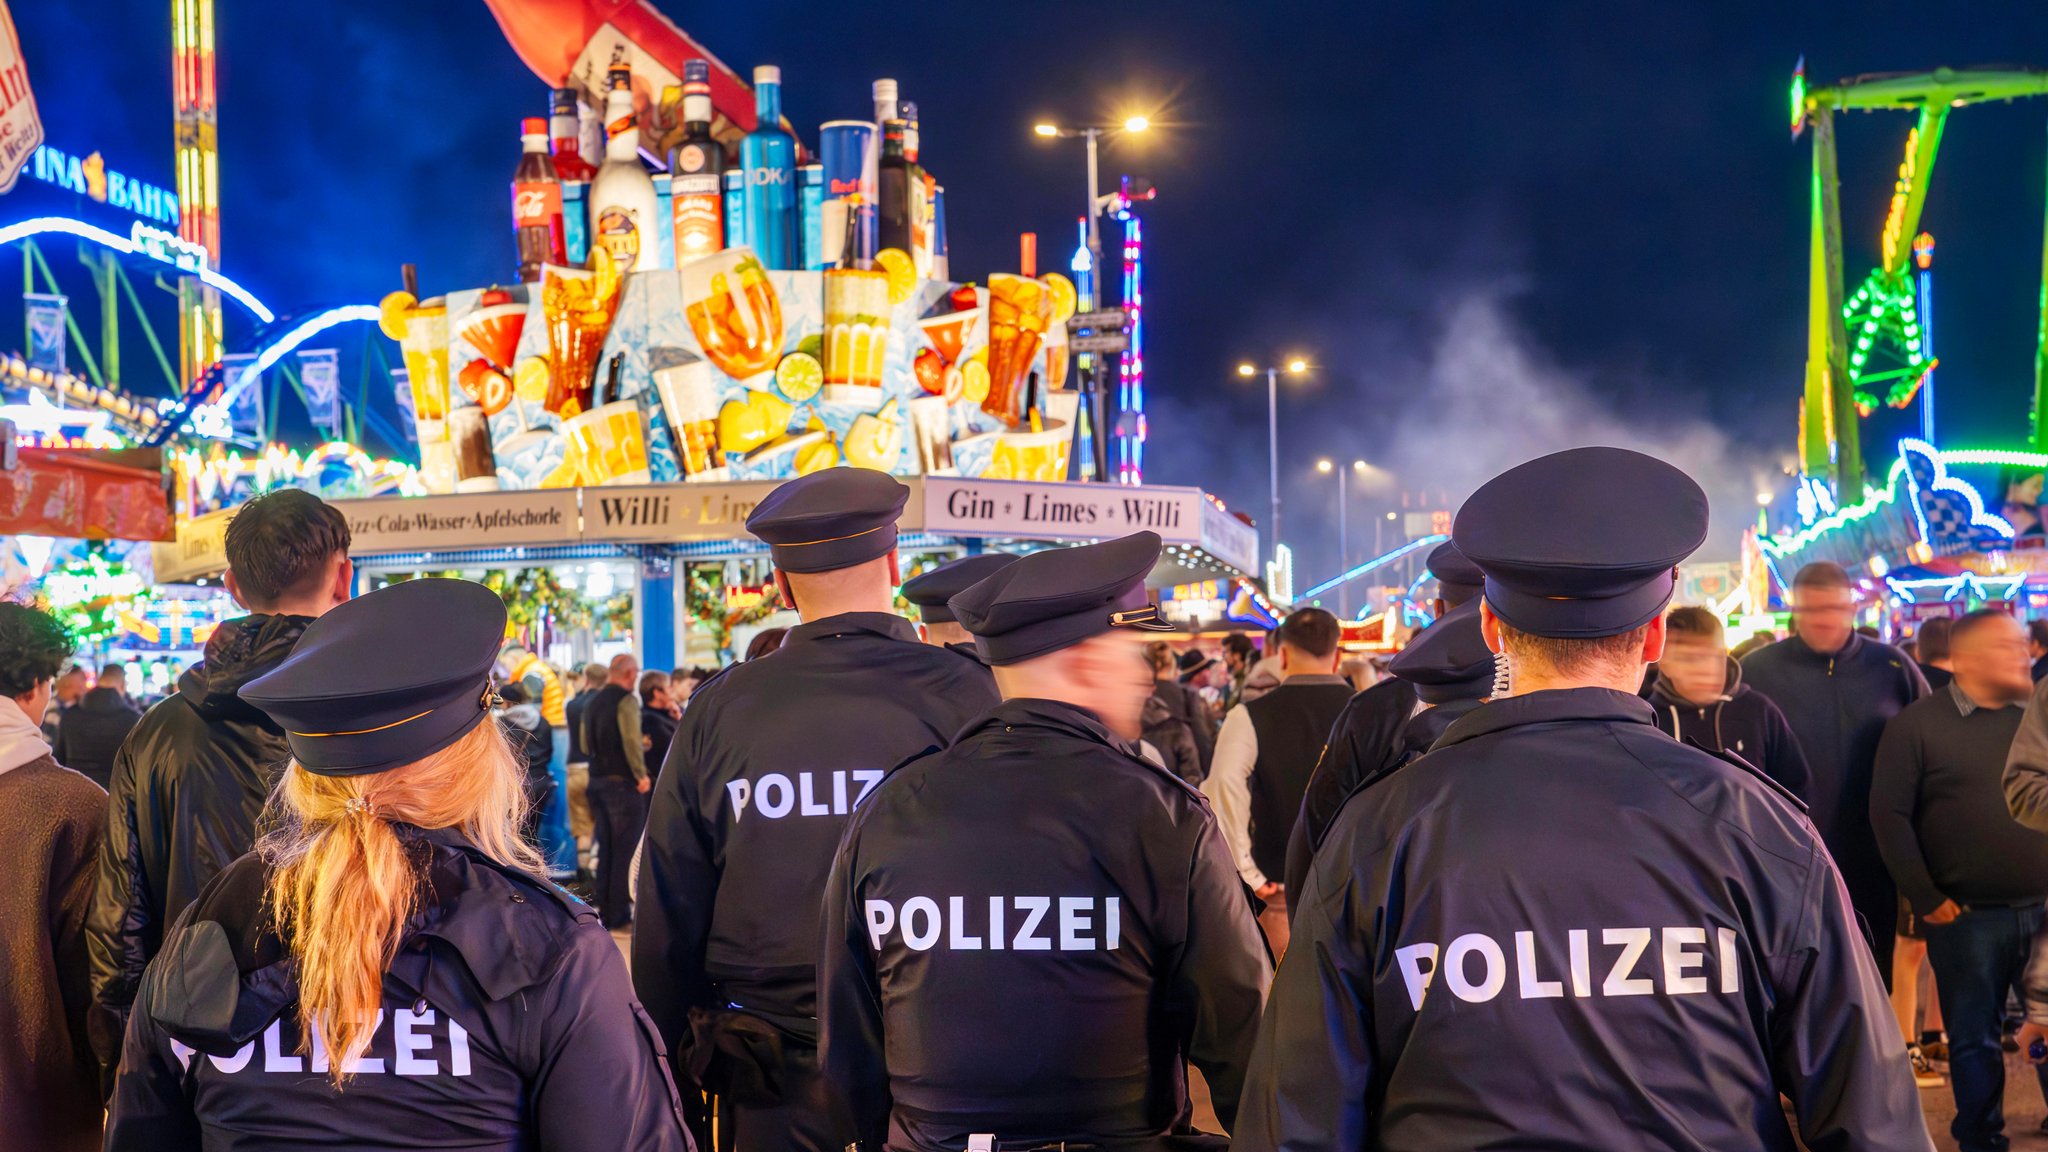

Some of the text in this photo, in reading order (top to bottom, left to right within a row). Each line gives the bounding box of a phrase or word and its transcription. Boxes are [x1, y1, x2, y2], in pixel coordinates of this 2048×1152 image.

[22, 145, 179, 226] INA BAHN
[472, 506, 561, 532] Apfelschorle
[600, 494, 757, 526] Willi Lim
[948, 488, 1180, 527] Gin Limes Willi
[726, 769, 885, 824] POLIZ
[865, 896, 1121, 952] POLIZEI
[1395, 927, 1739, 1013] POLIZEI
